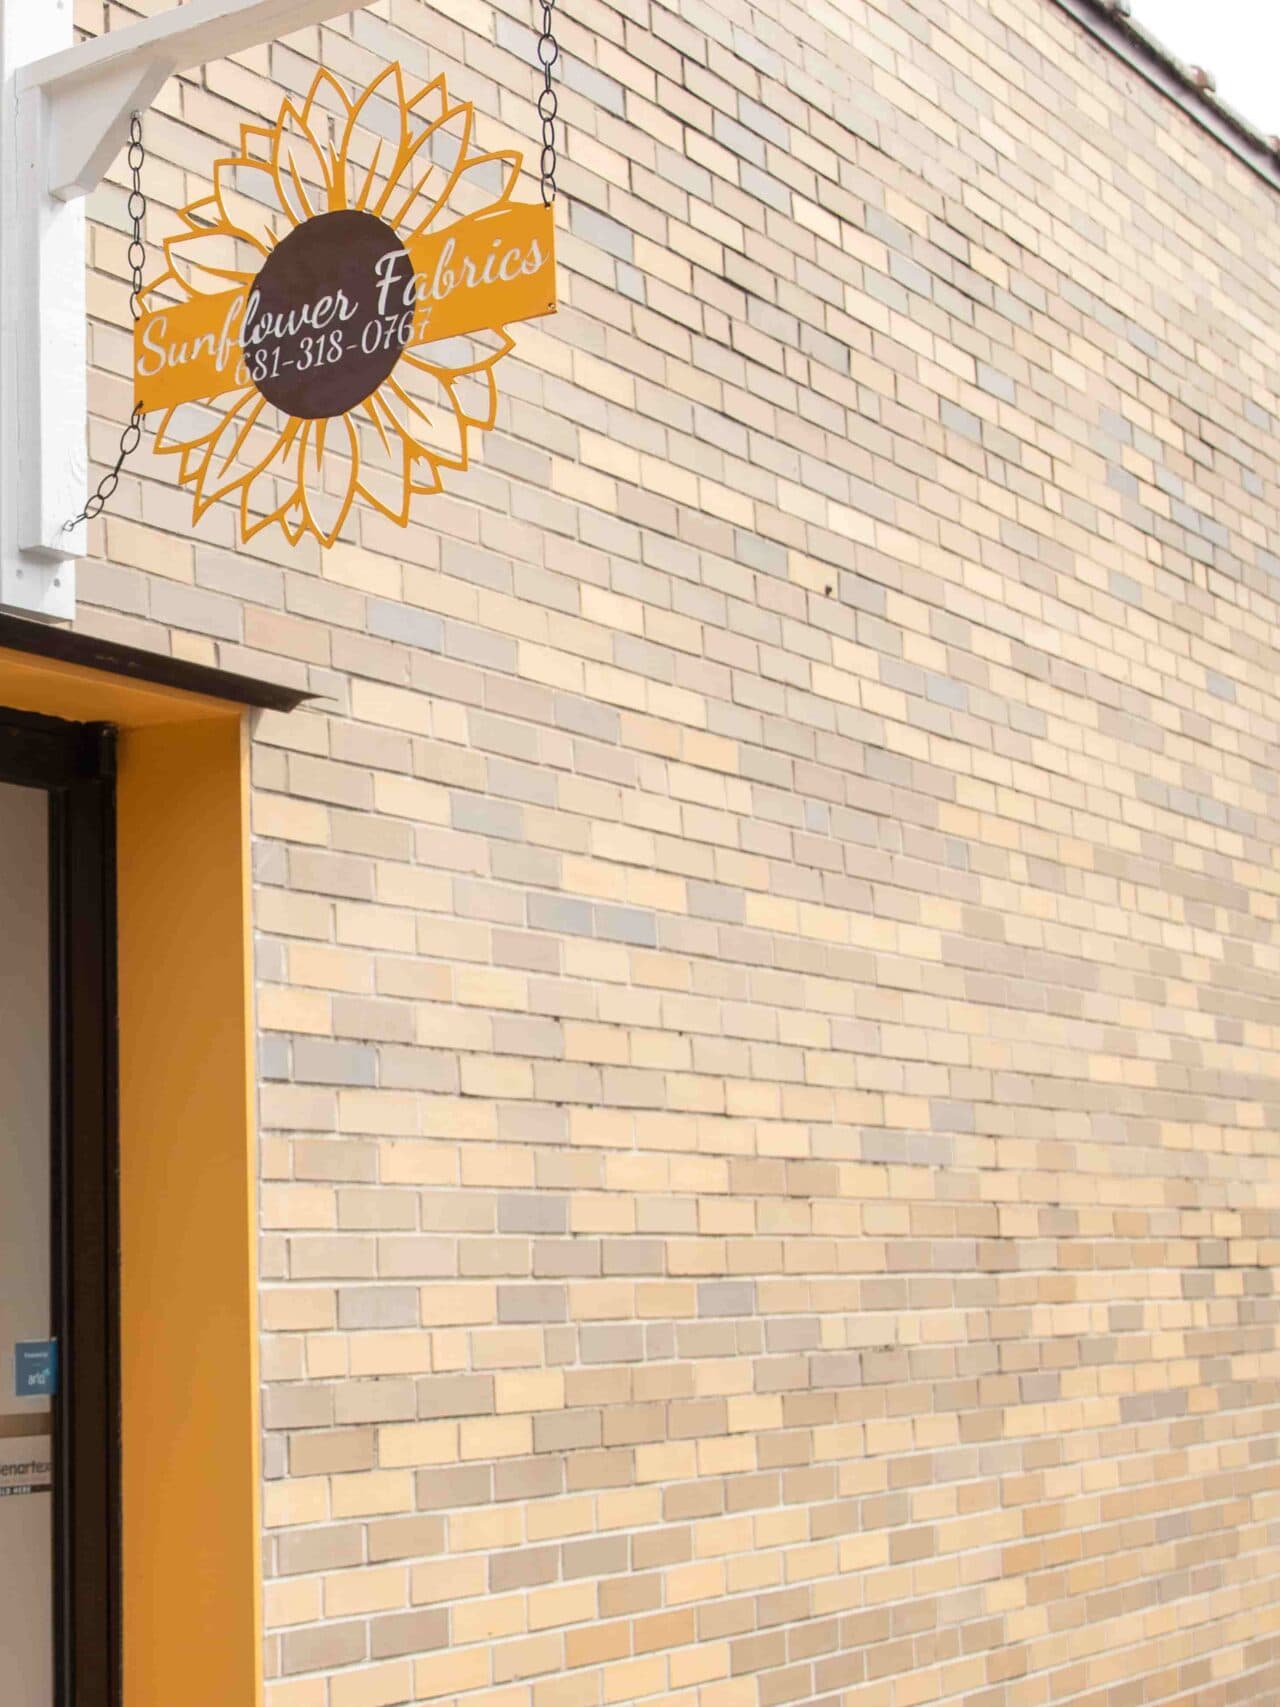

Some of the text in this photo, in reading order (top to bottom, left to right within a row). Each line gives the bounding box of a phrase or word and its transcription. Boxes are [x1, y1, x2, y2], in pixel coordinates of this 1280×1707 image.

[137, 237, 550, 377] Sunflower Fabrics
[233, 306, 433, 386] 681-318-0767
